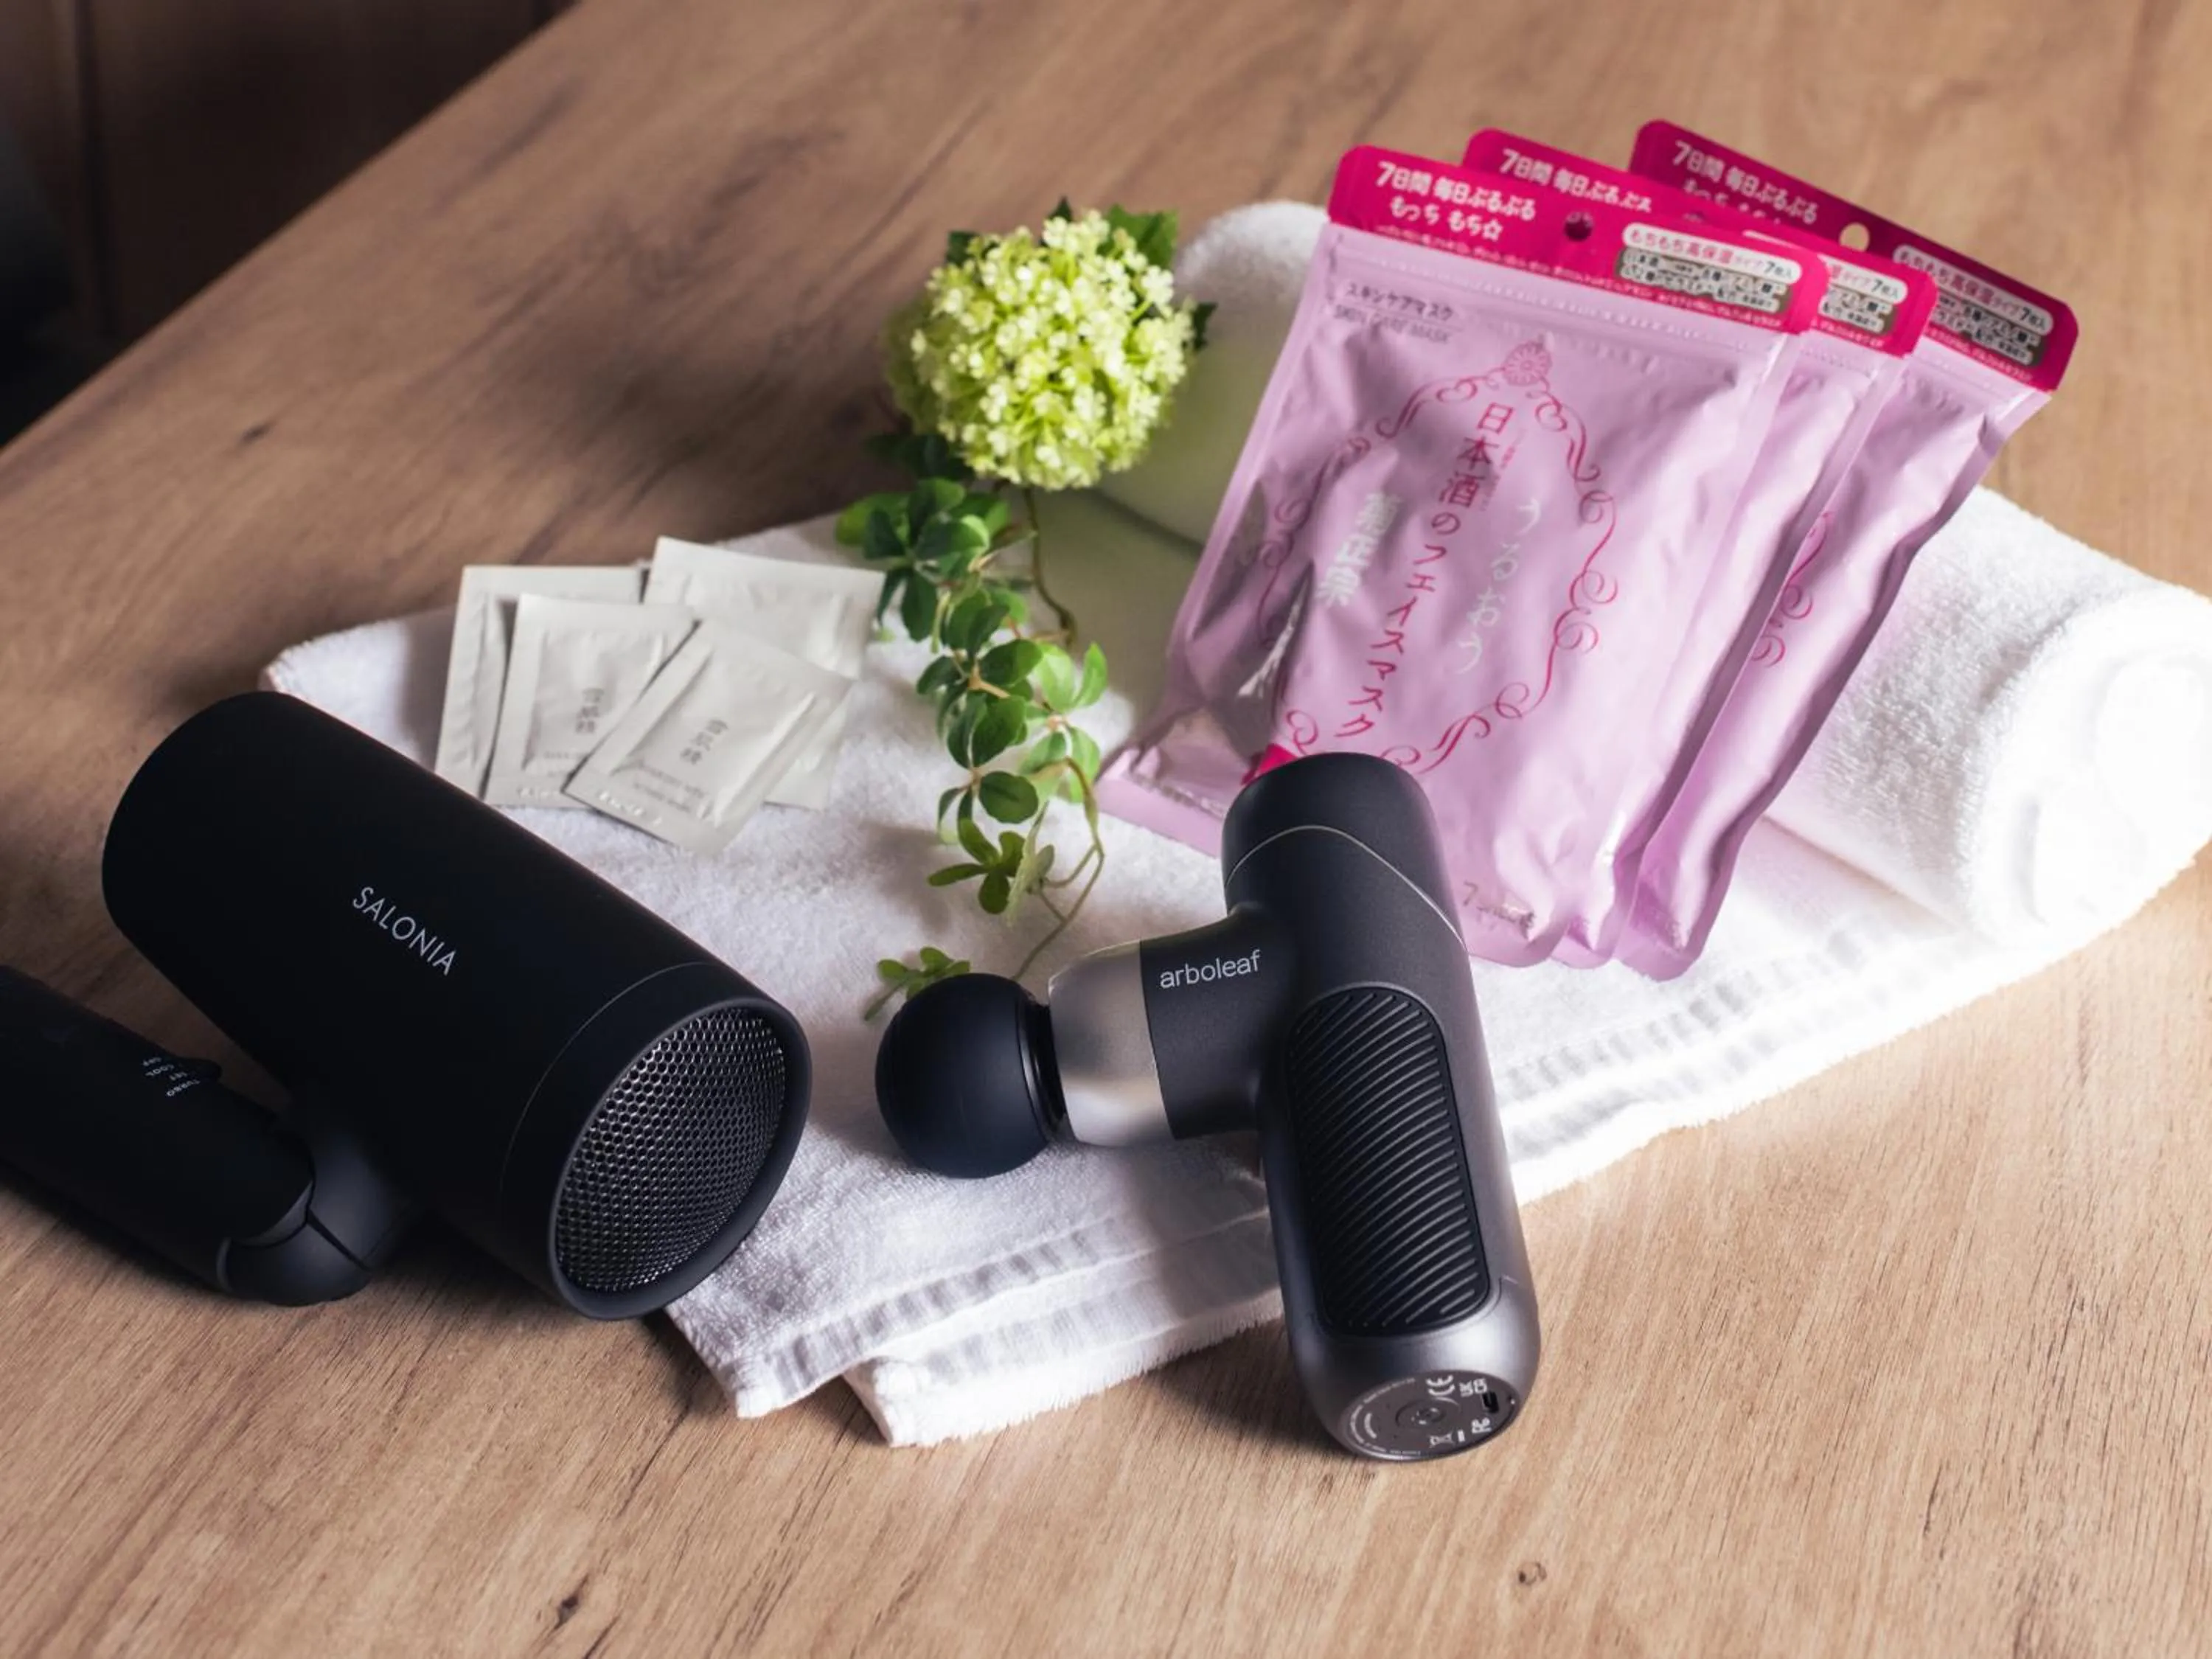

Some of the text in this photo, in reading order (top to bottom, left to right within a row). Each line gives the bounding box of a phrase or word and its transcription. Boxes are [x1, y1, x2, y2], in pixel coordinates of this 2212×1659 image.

[1376, 160, 1432, 196] 7日間
[1500, 147, 1554, 186] 7日間
[1673, 140, 1725, 182] 7日間
[352, 886, 456, 976] SALONIA
[1160, 949, 1262, 990] arboleaf
